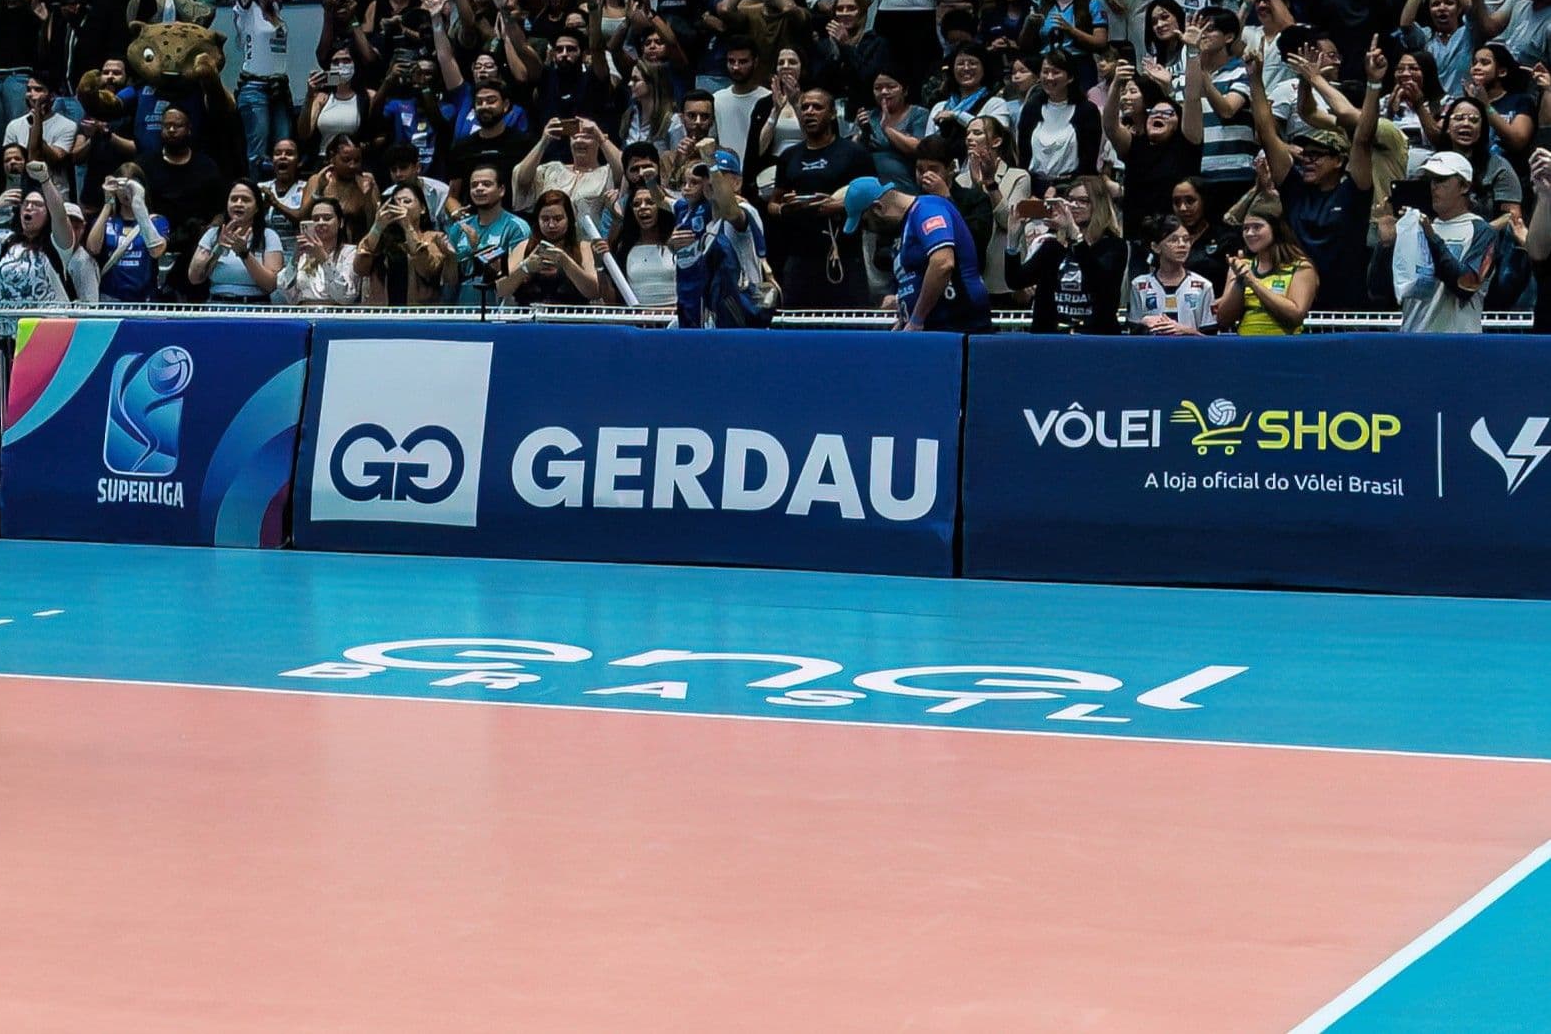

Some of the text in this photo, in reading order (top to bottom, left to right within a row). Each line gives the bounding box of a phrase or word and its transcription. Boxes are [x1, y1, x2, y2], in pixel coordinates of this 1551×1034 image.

[1024, 401, 1402, 453] VÔLEI SHOP
[97, 477, 186, 509] SUPERLIGA
[511, 426, 940, 522] GERDAU
[1144, 471, 1404, 496] A loja oficial do Vôlei Brasil
[278, 661, 1132, 724] BRASIL
[343, 637, 1251, 711] enel
